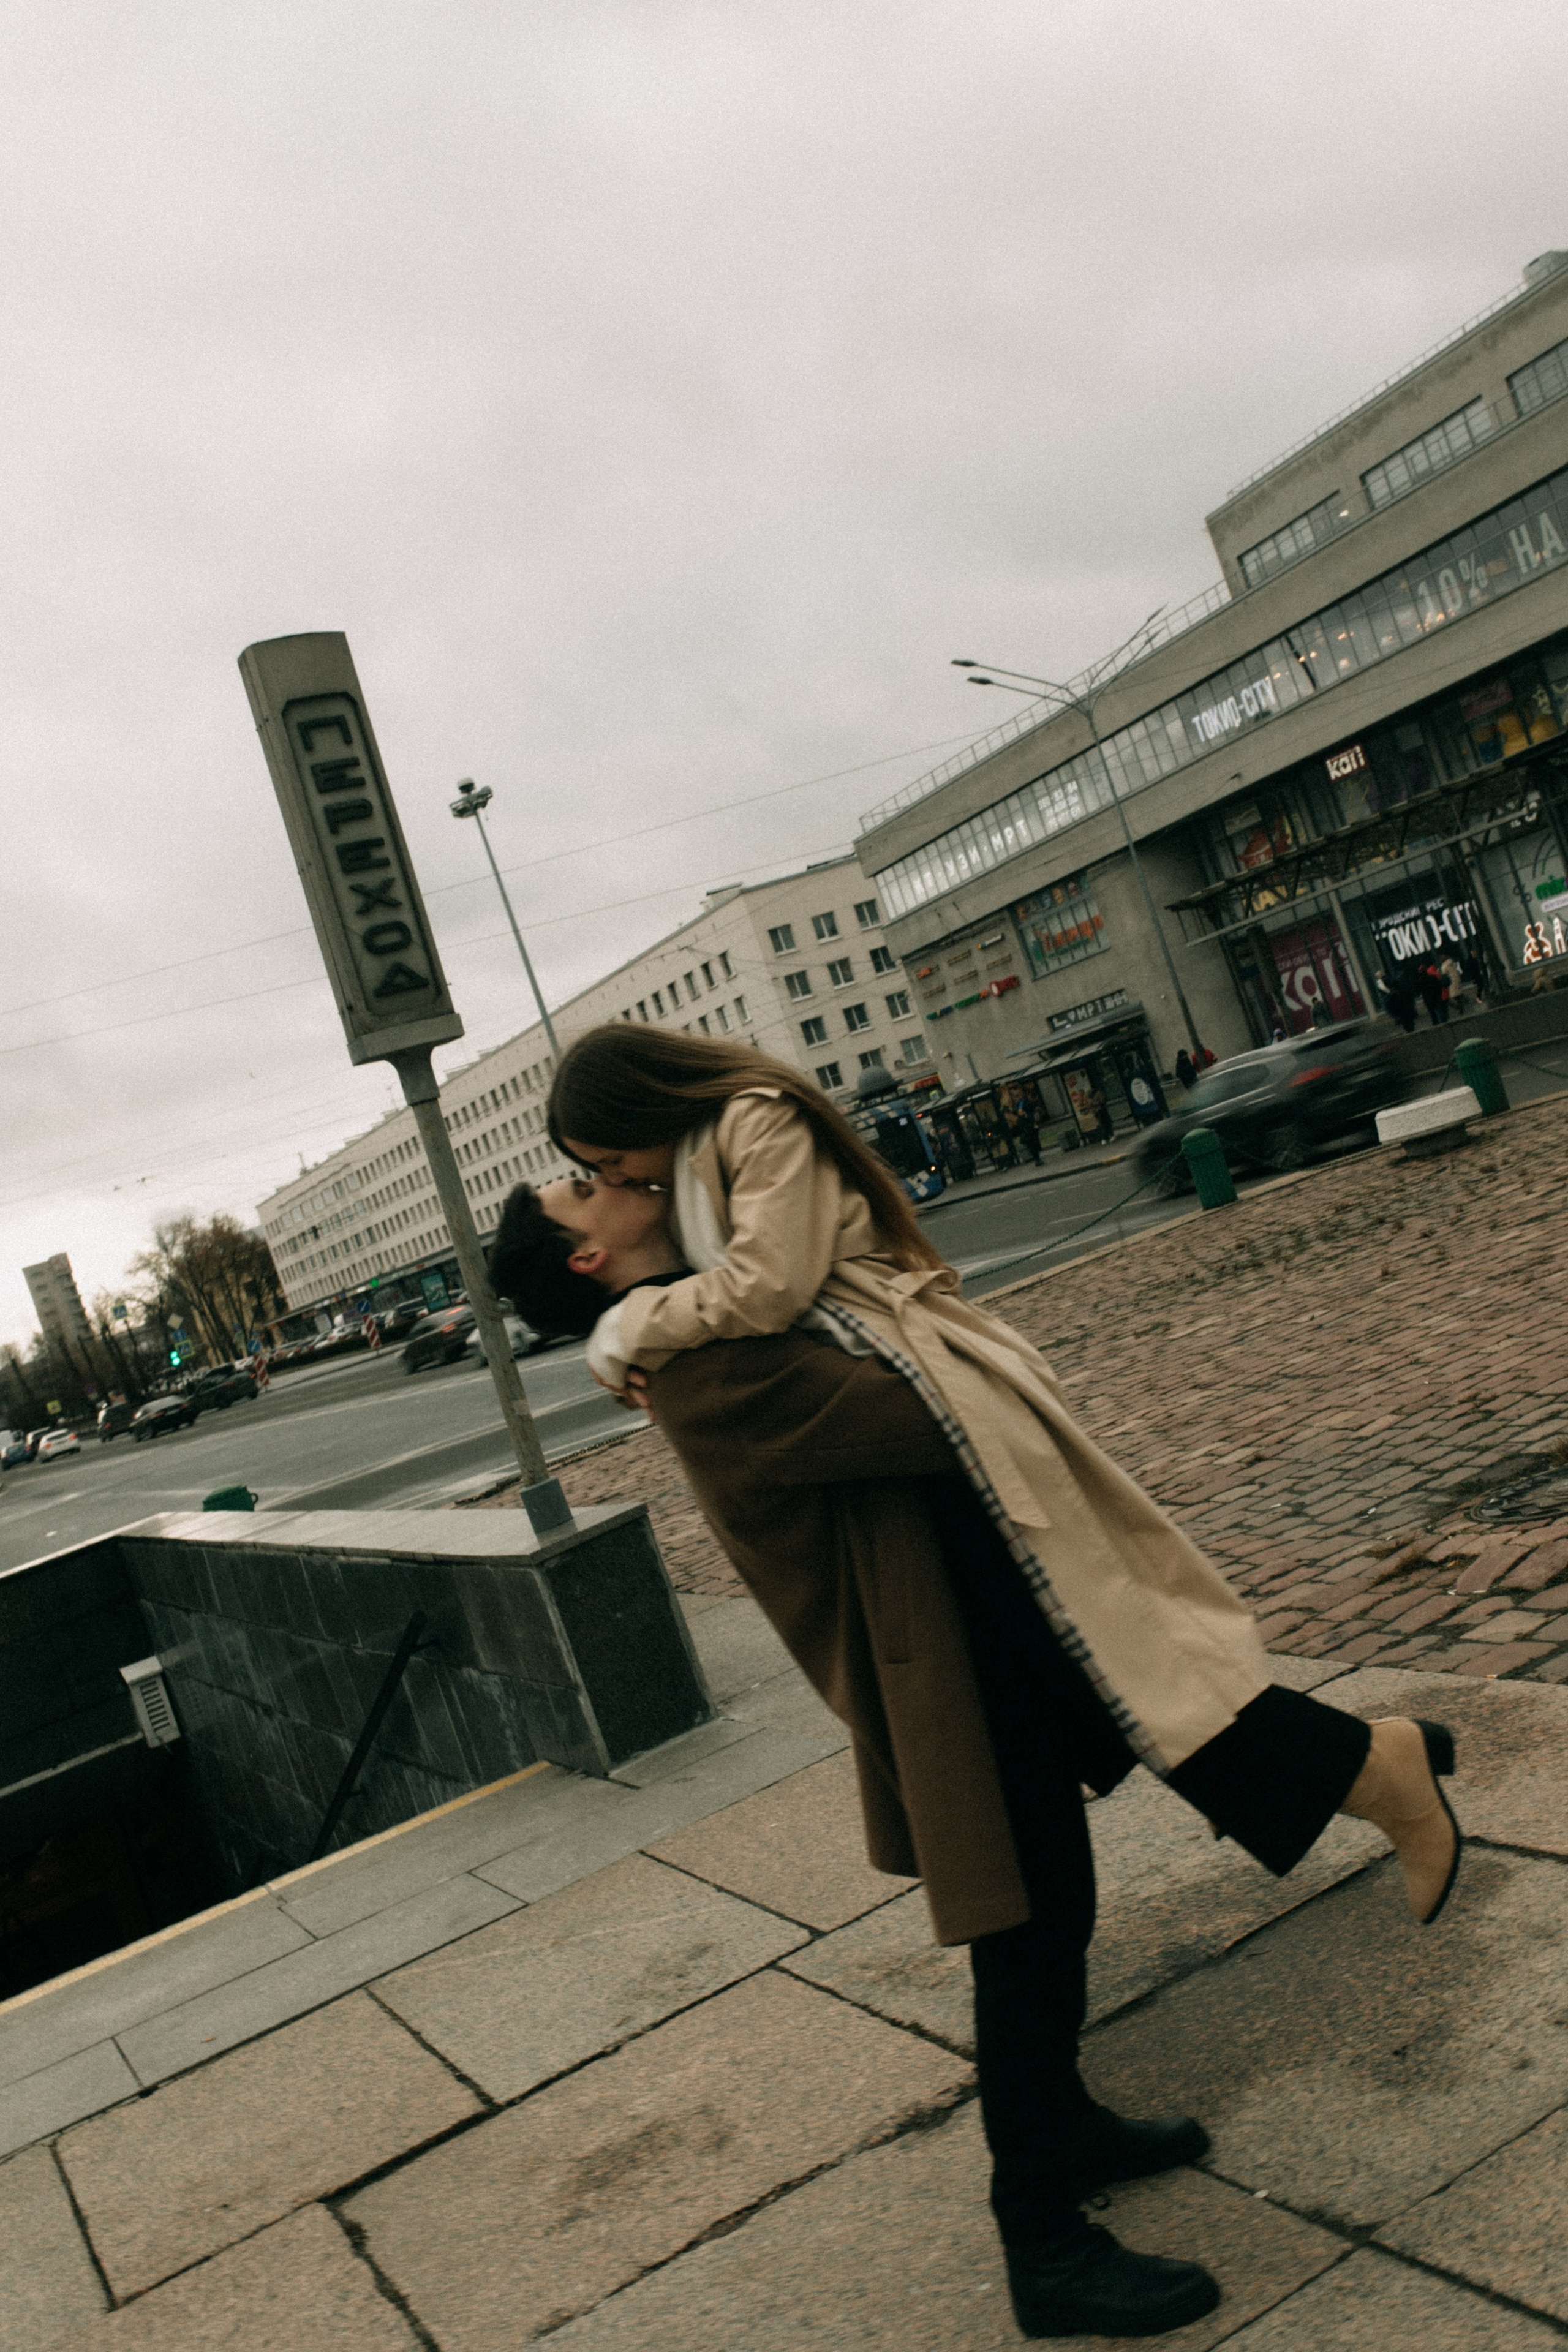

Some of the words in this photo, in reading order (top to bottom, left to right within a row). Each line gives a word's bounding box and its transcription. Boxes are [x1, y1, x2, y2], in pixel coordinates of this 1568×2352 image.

[1509, 511, 1566, 575] НА
[1192, 676, 1276, 742] ТОКИО-CITY
[1325, 745, 1366, 780] kari
[297, 714, 429, 998] ПЕРЕХОД
[944, 846, 980, 877] УЗИ
[990, 819, 1027, 852] МРТ
